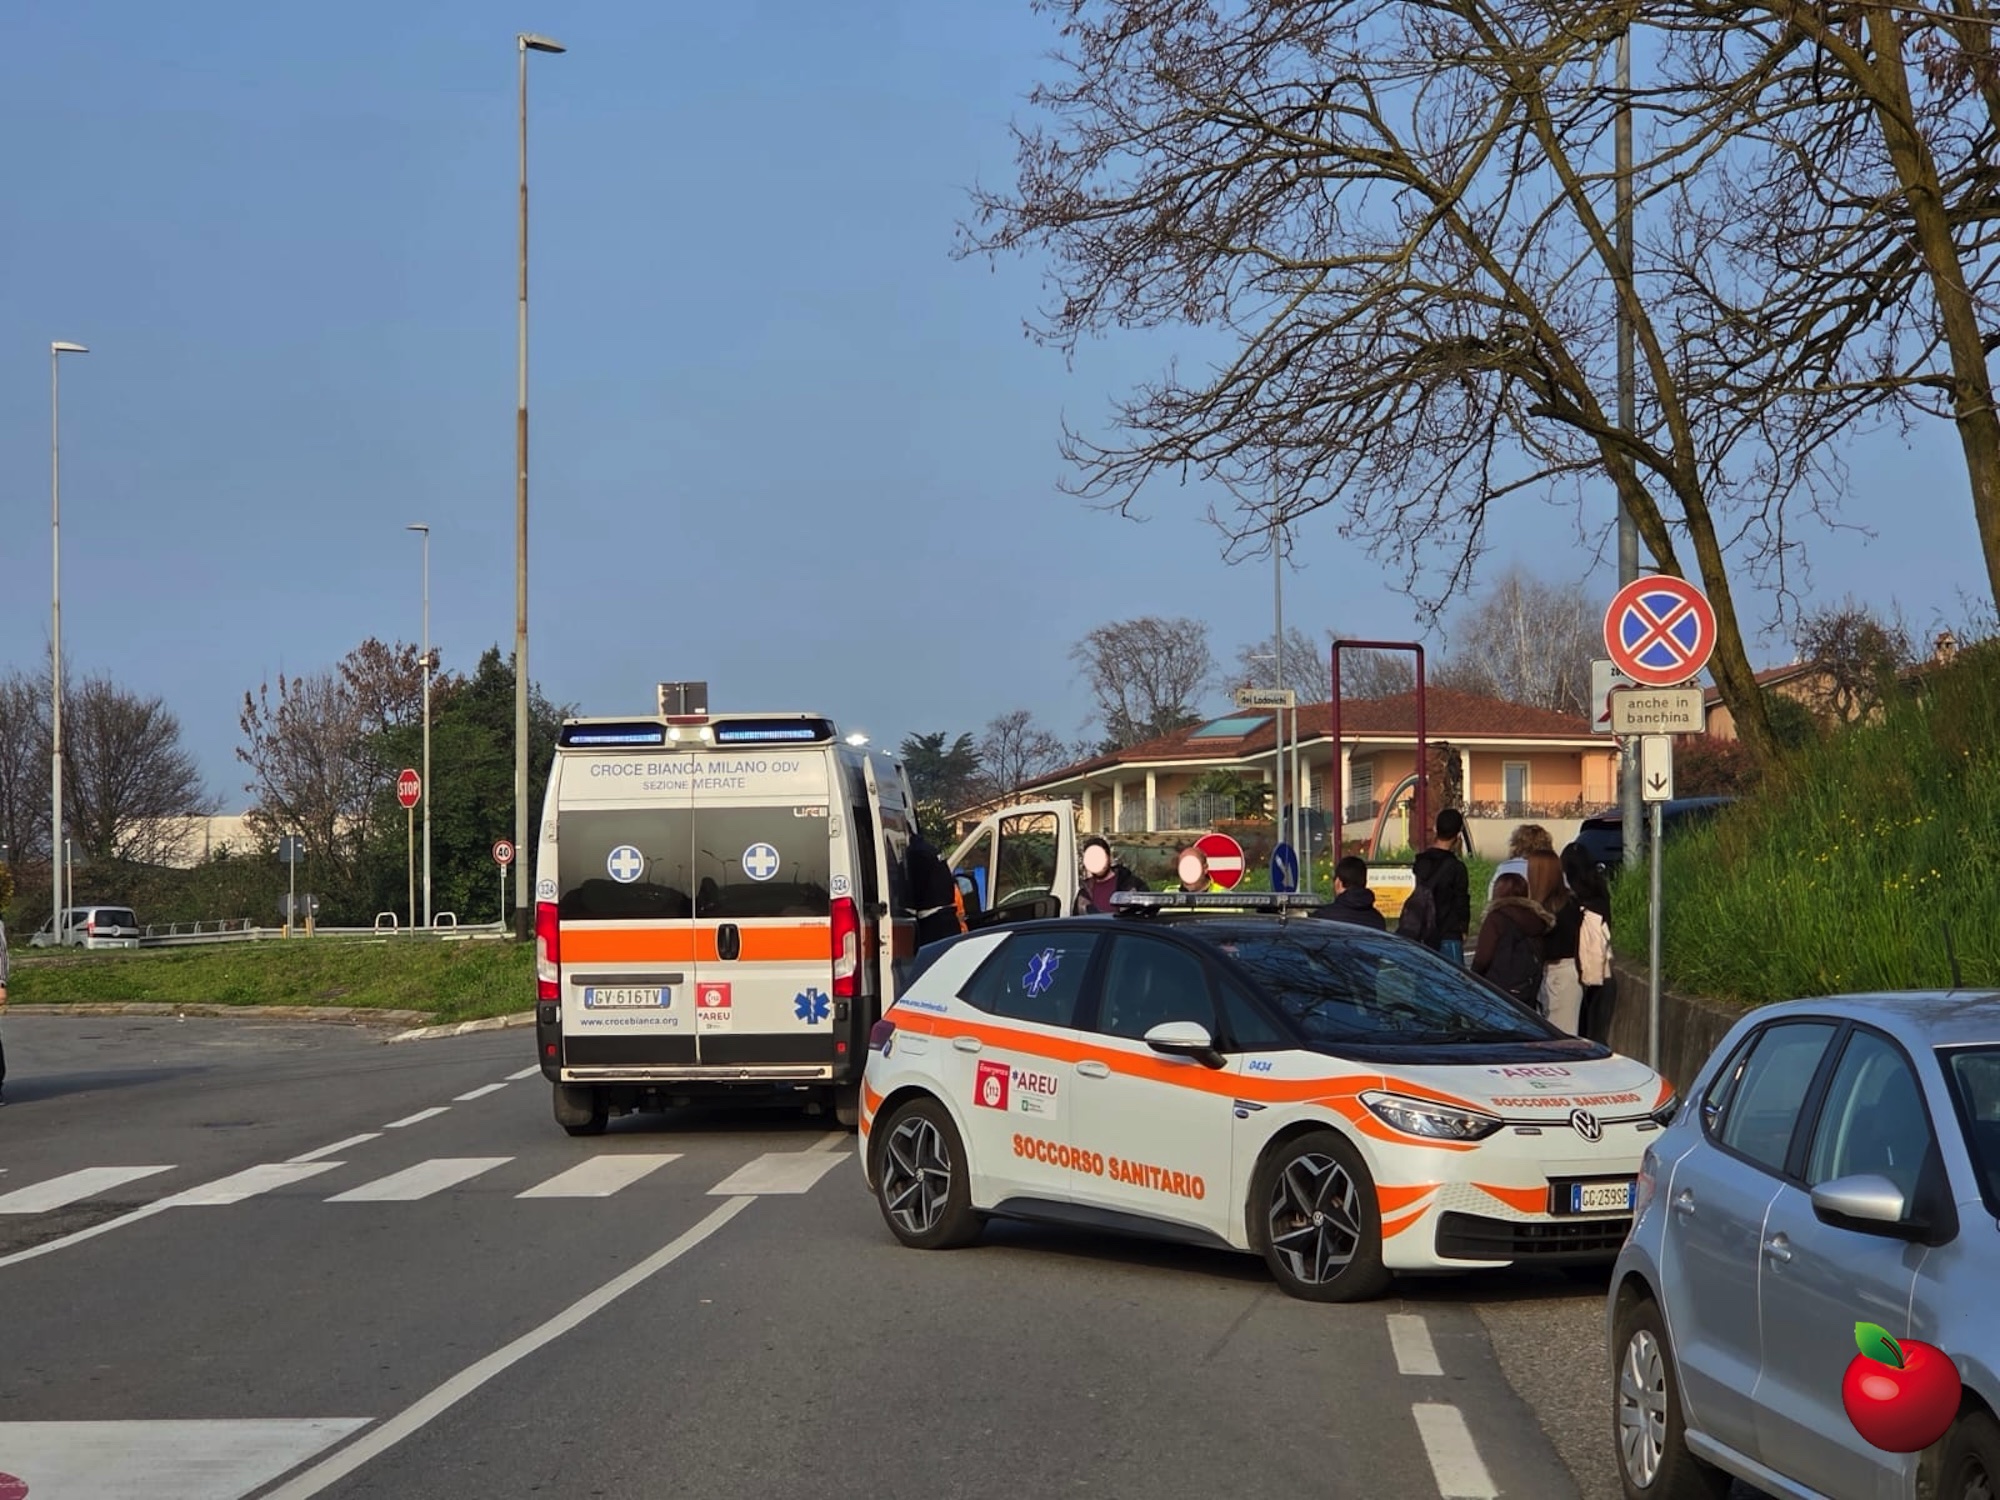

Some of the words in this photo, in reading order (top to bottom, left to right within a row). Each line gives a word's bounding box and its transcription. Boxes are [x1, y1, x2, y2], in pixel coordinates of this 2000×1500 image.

[1627, 697, 1669, 709] anche
[1676, 696, 1689, 708] in
[1627, 711, 1690, 724] banchina
[590, 763, 643, 776] CROCE
[647, 762, 704, 776] BIANCA
[708, 761, 767, 774] MILANO
[772, 761, 800, 773] ODV
[400, 781, 418, 796] STOP
[643, 780, 689, 790] SEZIONE
[692, 777, 745, 790] MERATE
[498, 847, 510, 857] 40
[834, 879, 847, 891] 324
[580, 1017, 679, 1027] www.crocebianca.org
[703, 1012, 731, 1021] AREU
[1502, 1066, 1571, 1078] AREU
[1017, 1071, 1058, 1096] AREU
[1491, 1097, 1571, 1107] SOCCORSO
[1573, 1093, 1641, 1107] SANITARIO
[1013, 1133, 1104, 1176] SOCCORSO
[1108, 1156, 1205, 1200] SANITARIO
